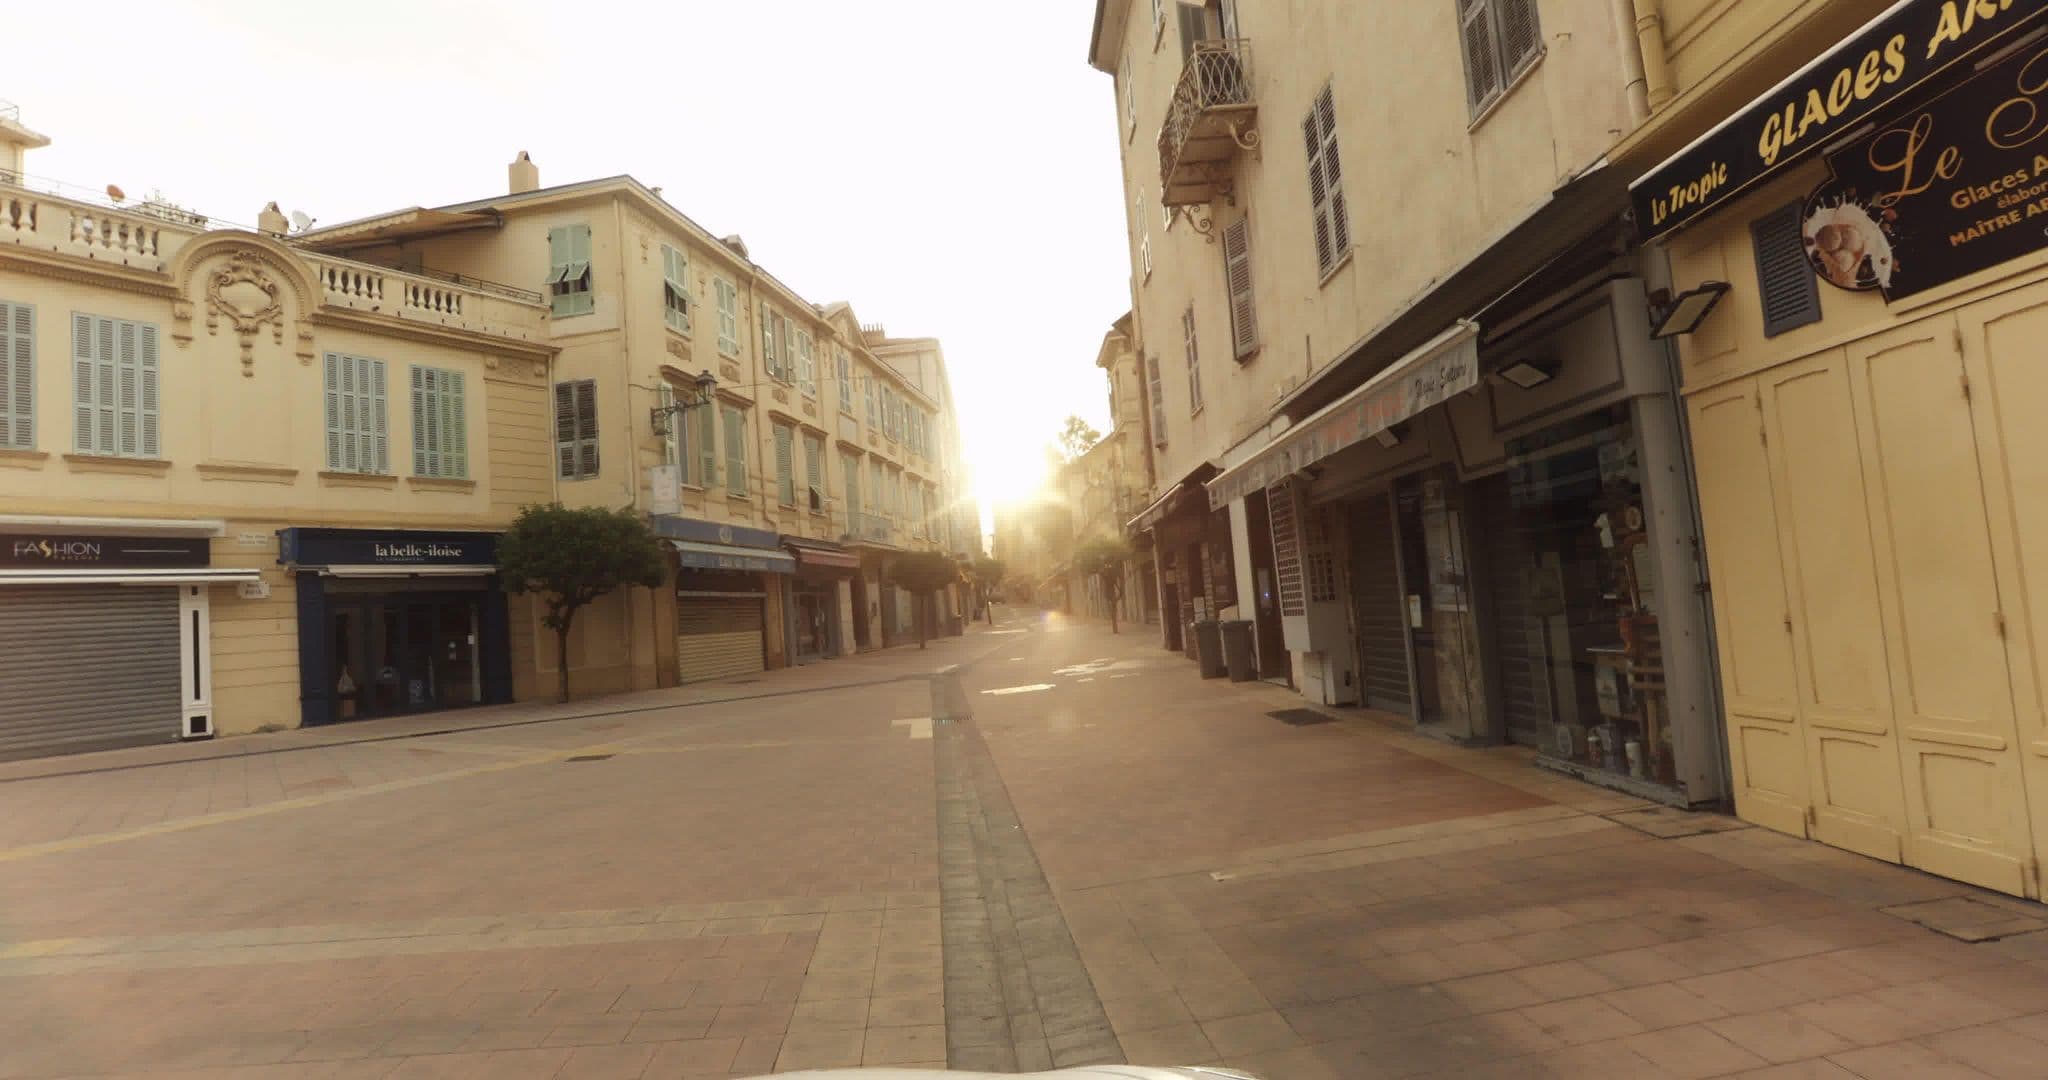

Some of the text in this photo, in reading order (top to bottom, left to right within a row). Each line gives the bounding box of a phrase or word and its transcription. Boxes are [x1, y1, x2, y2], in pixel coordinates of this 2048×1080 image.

[1652, 197, 1667, 226] Le
[1669, 161, 1728, 214] Tropic
[1758, 34, 1907, 166] GLACES
[1869, 113, 1964, 209] Le
[1951, 168, 2030, 210] Glaces
[1949, 210, 2022, 248] MAÎTRE
[13, 540, 101, 557] FASHION
[375, 544, 388, 556] la
